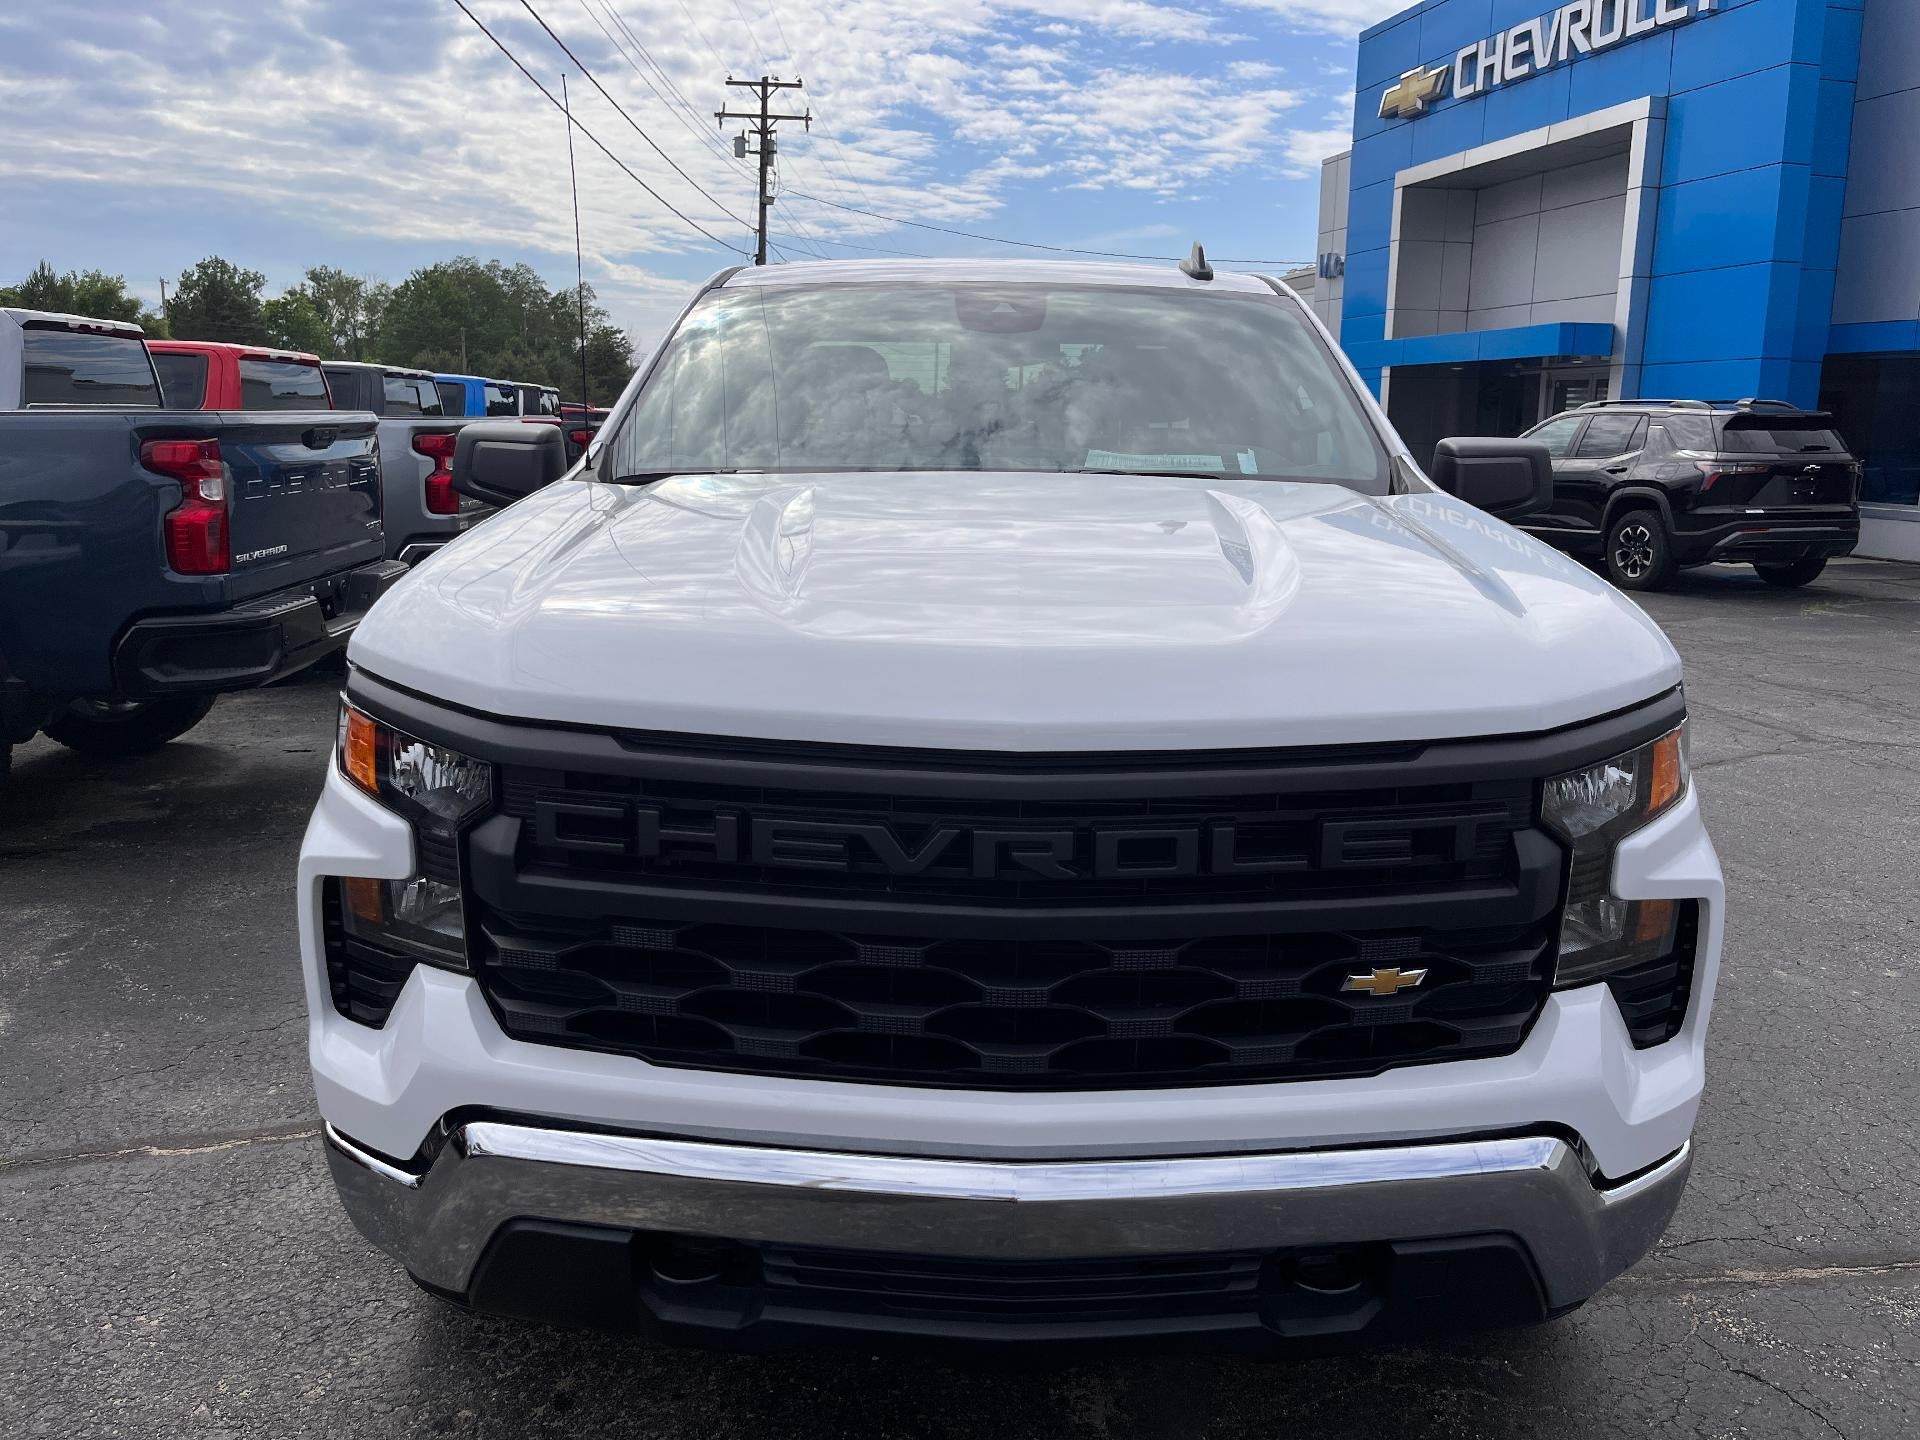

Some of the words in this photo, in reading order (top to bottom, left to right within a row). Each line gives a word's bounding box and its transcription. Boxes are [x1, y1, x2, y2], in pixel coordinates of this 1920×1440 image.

[1452, 0, 1711, 98] CHEVROL
[235, 544, 288, 563] SILVERADO
[533, 799, 1505, 878] CHEVROLET
